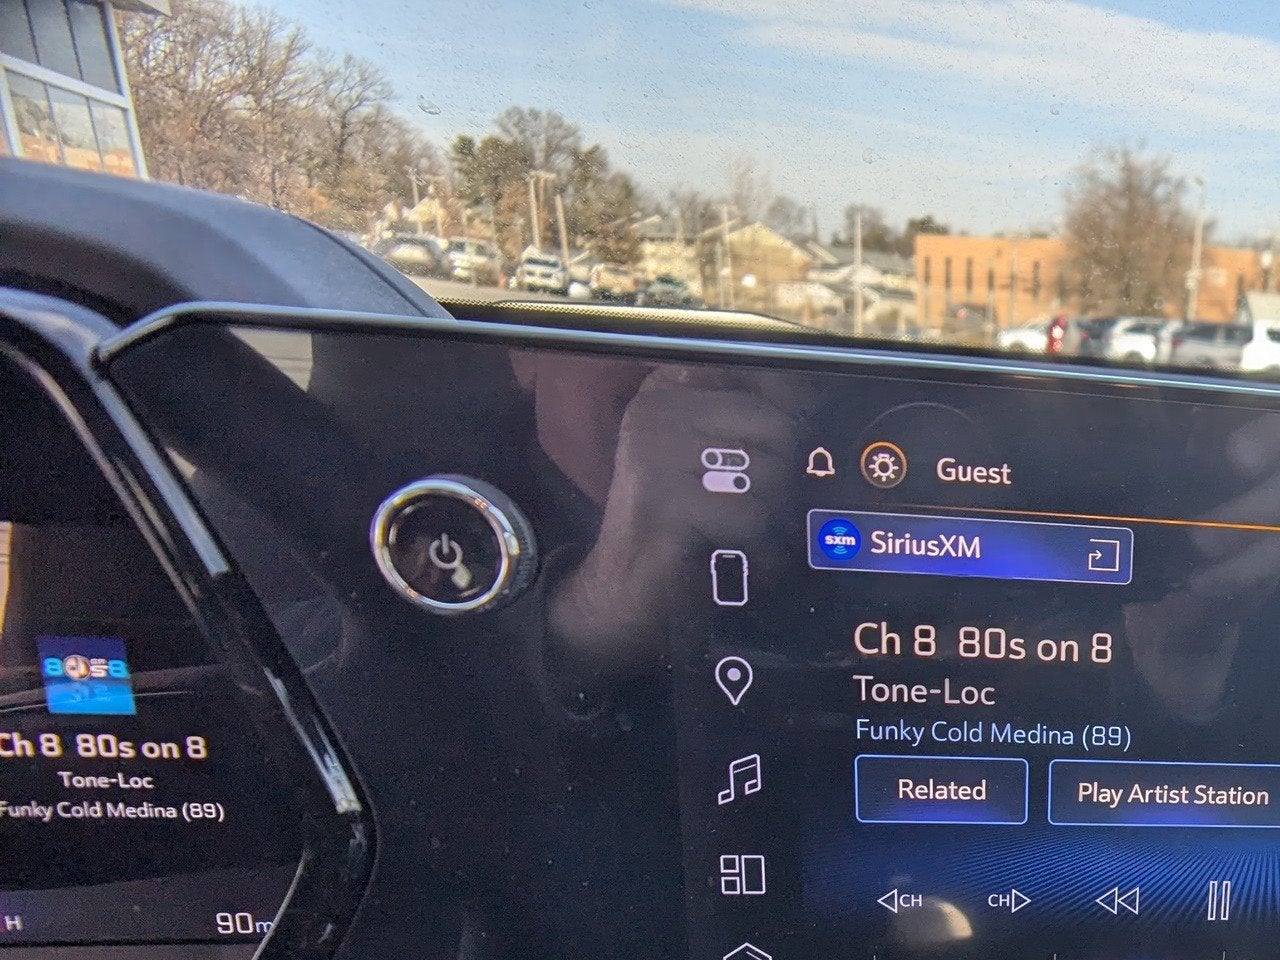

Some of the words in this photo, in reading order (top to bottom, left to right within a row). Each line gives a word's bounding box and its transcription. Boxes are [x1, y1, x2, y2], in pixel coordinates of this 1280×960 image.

[936, 457, 1012, 485] Guest
[824, 533, 856, 547] sxm
[870, 531, 982, 559] SiriusXM
[853, 622, 901, 656] Ch
[913, 624, 937, 657] 8
[958, 626, 1027, 660] 80s
[1036, 640, 1079, 663] on
[1090, 632, 1114, 664] 8
[853, 674, 996, 706] Tone-Loc
[40, 733, 62, 758] 8
[76, 733, 136, 758] 80s
[141, 743, 180, 758] on
[186, 736, 208, 759] 8
[855, 718, 925, 745] Funky
[931, 719, 983, 744] Cold
[990, 722, 1075, 747] Medina
[1081, 724, 1132, 752] (89)
[58, 771, 154, 790] Tone-Loc
[897, 778, 987, 802] Related
[1077, 782, 1123, 809] Play
[1127, 784, 1189, 805] Artist
[1193, 785, 1270, 807] Station
[0, 802, 52, 822] Funky
[57, 801, 103, 818] Cold
[107, 802, 178, 819] Medina
[182, 802, 225, 822] (89)
[900, 893, 923, 908] CH
[987, 893, 1010, 908] CH
